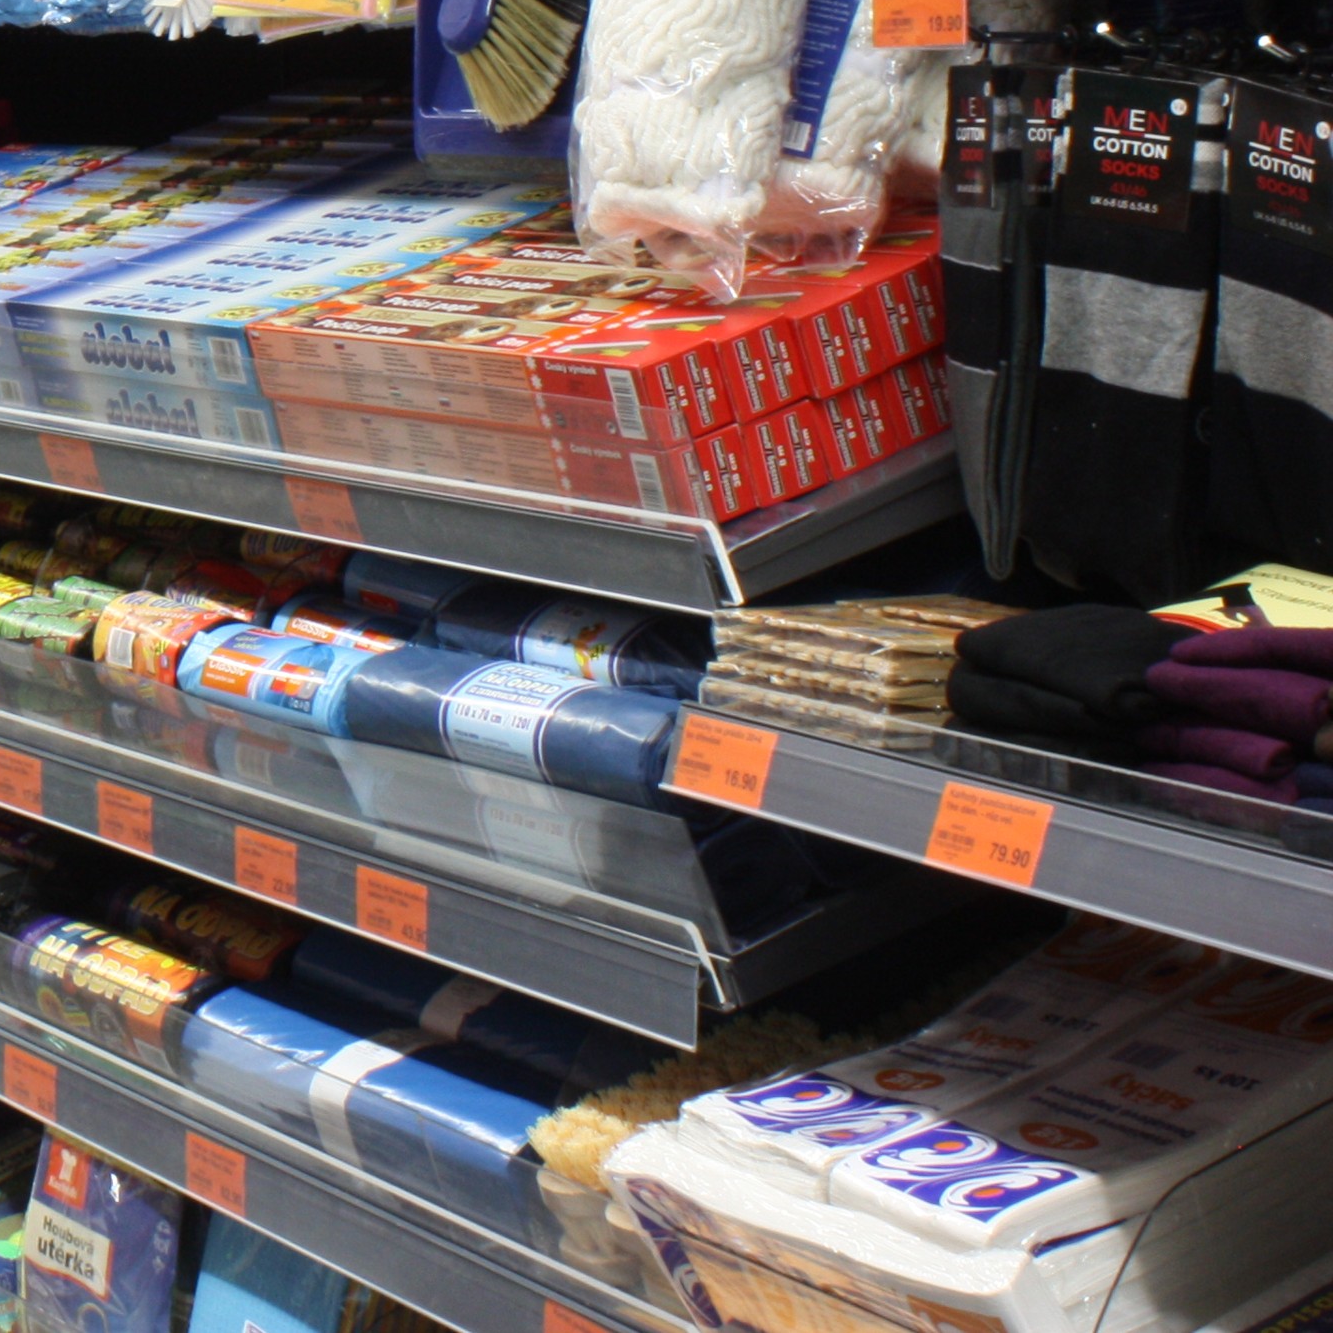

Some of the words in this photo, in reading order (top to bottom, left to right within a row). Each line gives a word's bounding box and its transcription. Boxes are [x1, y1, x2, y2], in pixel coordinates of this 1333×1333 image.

[928, 15, 962, 33] 19.90
[1103, 106, 1168, 133] MEN
[956, 126, 986, 142] COTTON
[1027, 128, 1054, 142] COT
[1257, 120, 1316, 157] MEN
[1093, 135, 1168, 160] COTTON
[1100, 159, 1161, 180] SOCKS
[1248, 151, 1314, 183] COTTON
[1256, 174, 1310, 203] SOCKS
[484, 671, 508, 685] NA
[508, 676, 561, 695] ODPAD
[454, 702, 470, 716] 110
[478, 706, 490, 719] 70
[491, 711, 503, 723] cm
[724, 767, 758, 793] 16.90
[988, 840, 1031, 868] 79.90
[31, 934, 79, 975] NA
[70, 950, 171, 1016] ODPAD
[43, 1215, 94, 1255] Houbová
